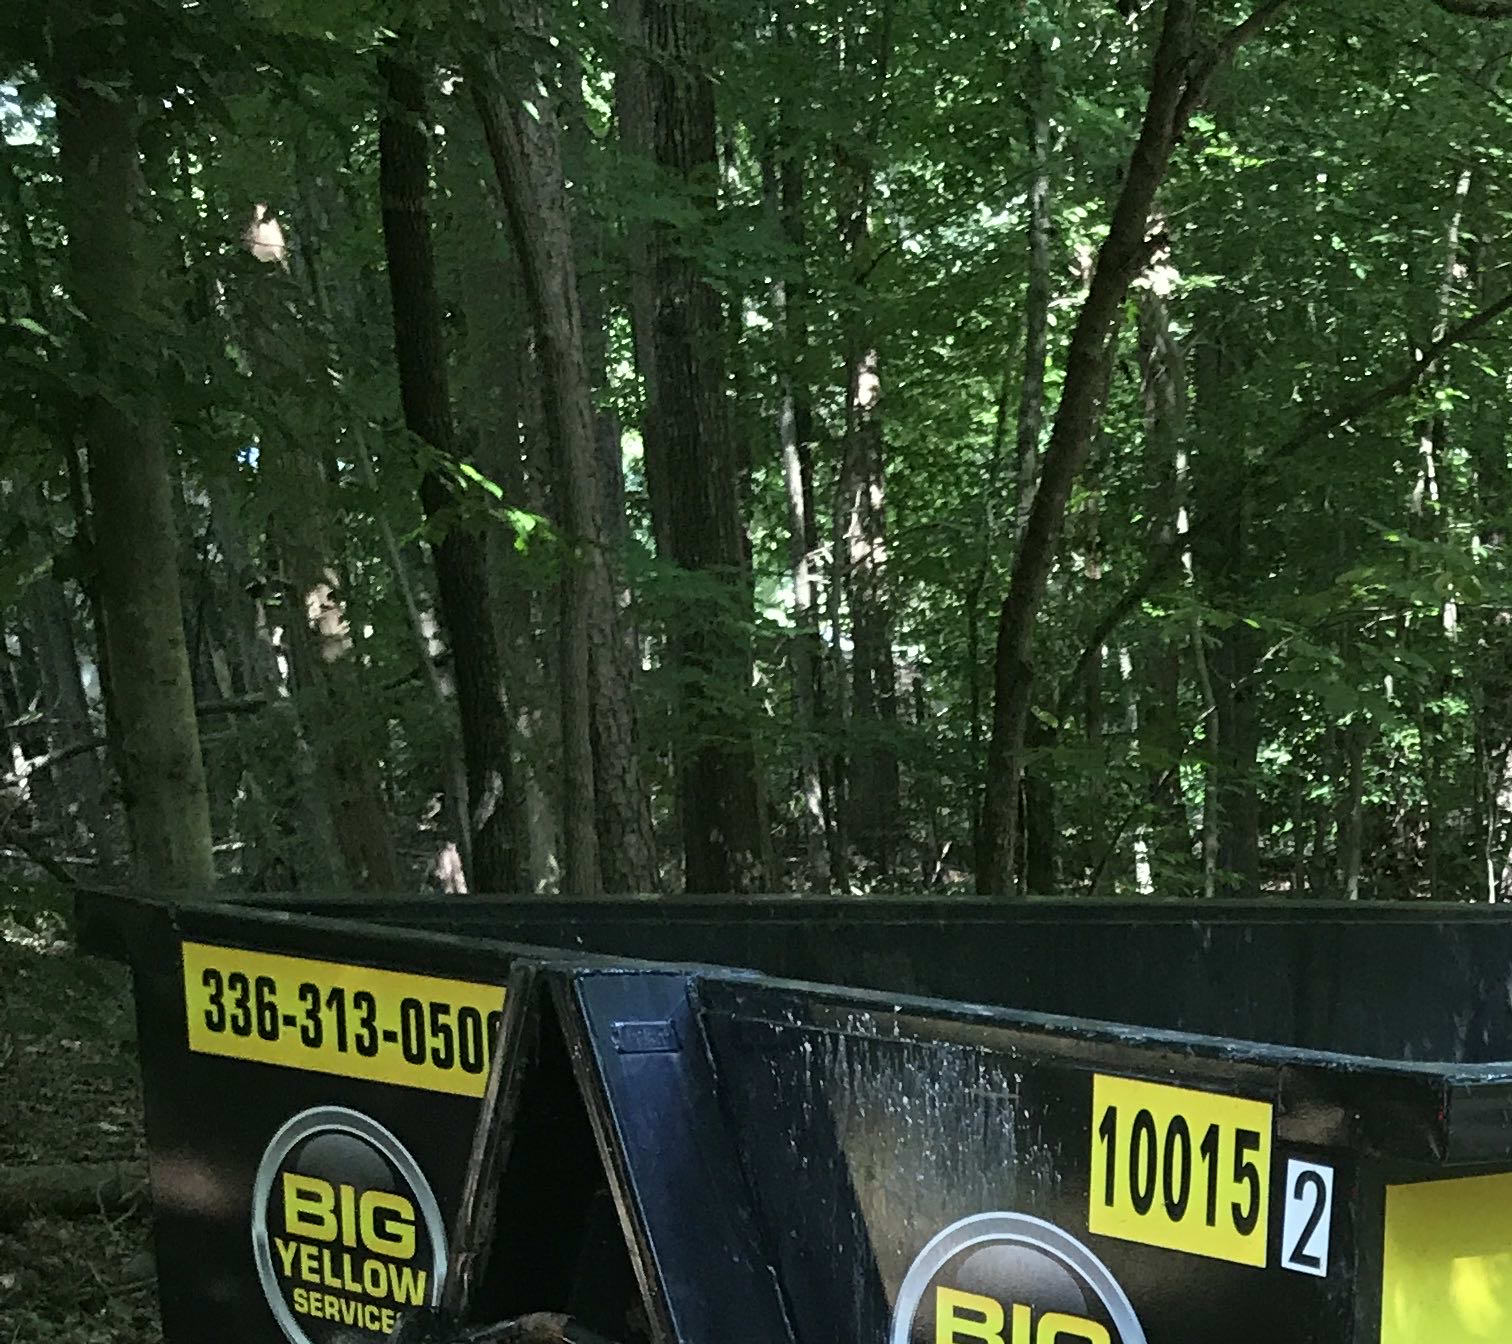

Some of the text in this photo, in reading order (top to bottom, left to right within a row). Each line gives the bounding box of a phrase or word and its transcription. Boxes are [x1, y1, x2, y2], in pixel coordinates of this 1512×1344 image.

[1098, 1105, 1261, 1236] 10015
[282, 1172, 417, 1260] BIG
[1288, 1170, 1328, 1269] 2
[274, 1238, 427, 1306] YELLOW
[293, 1287, 401, 1335] SERVICE
